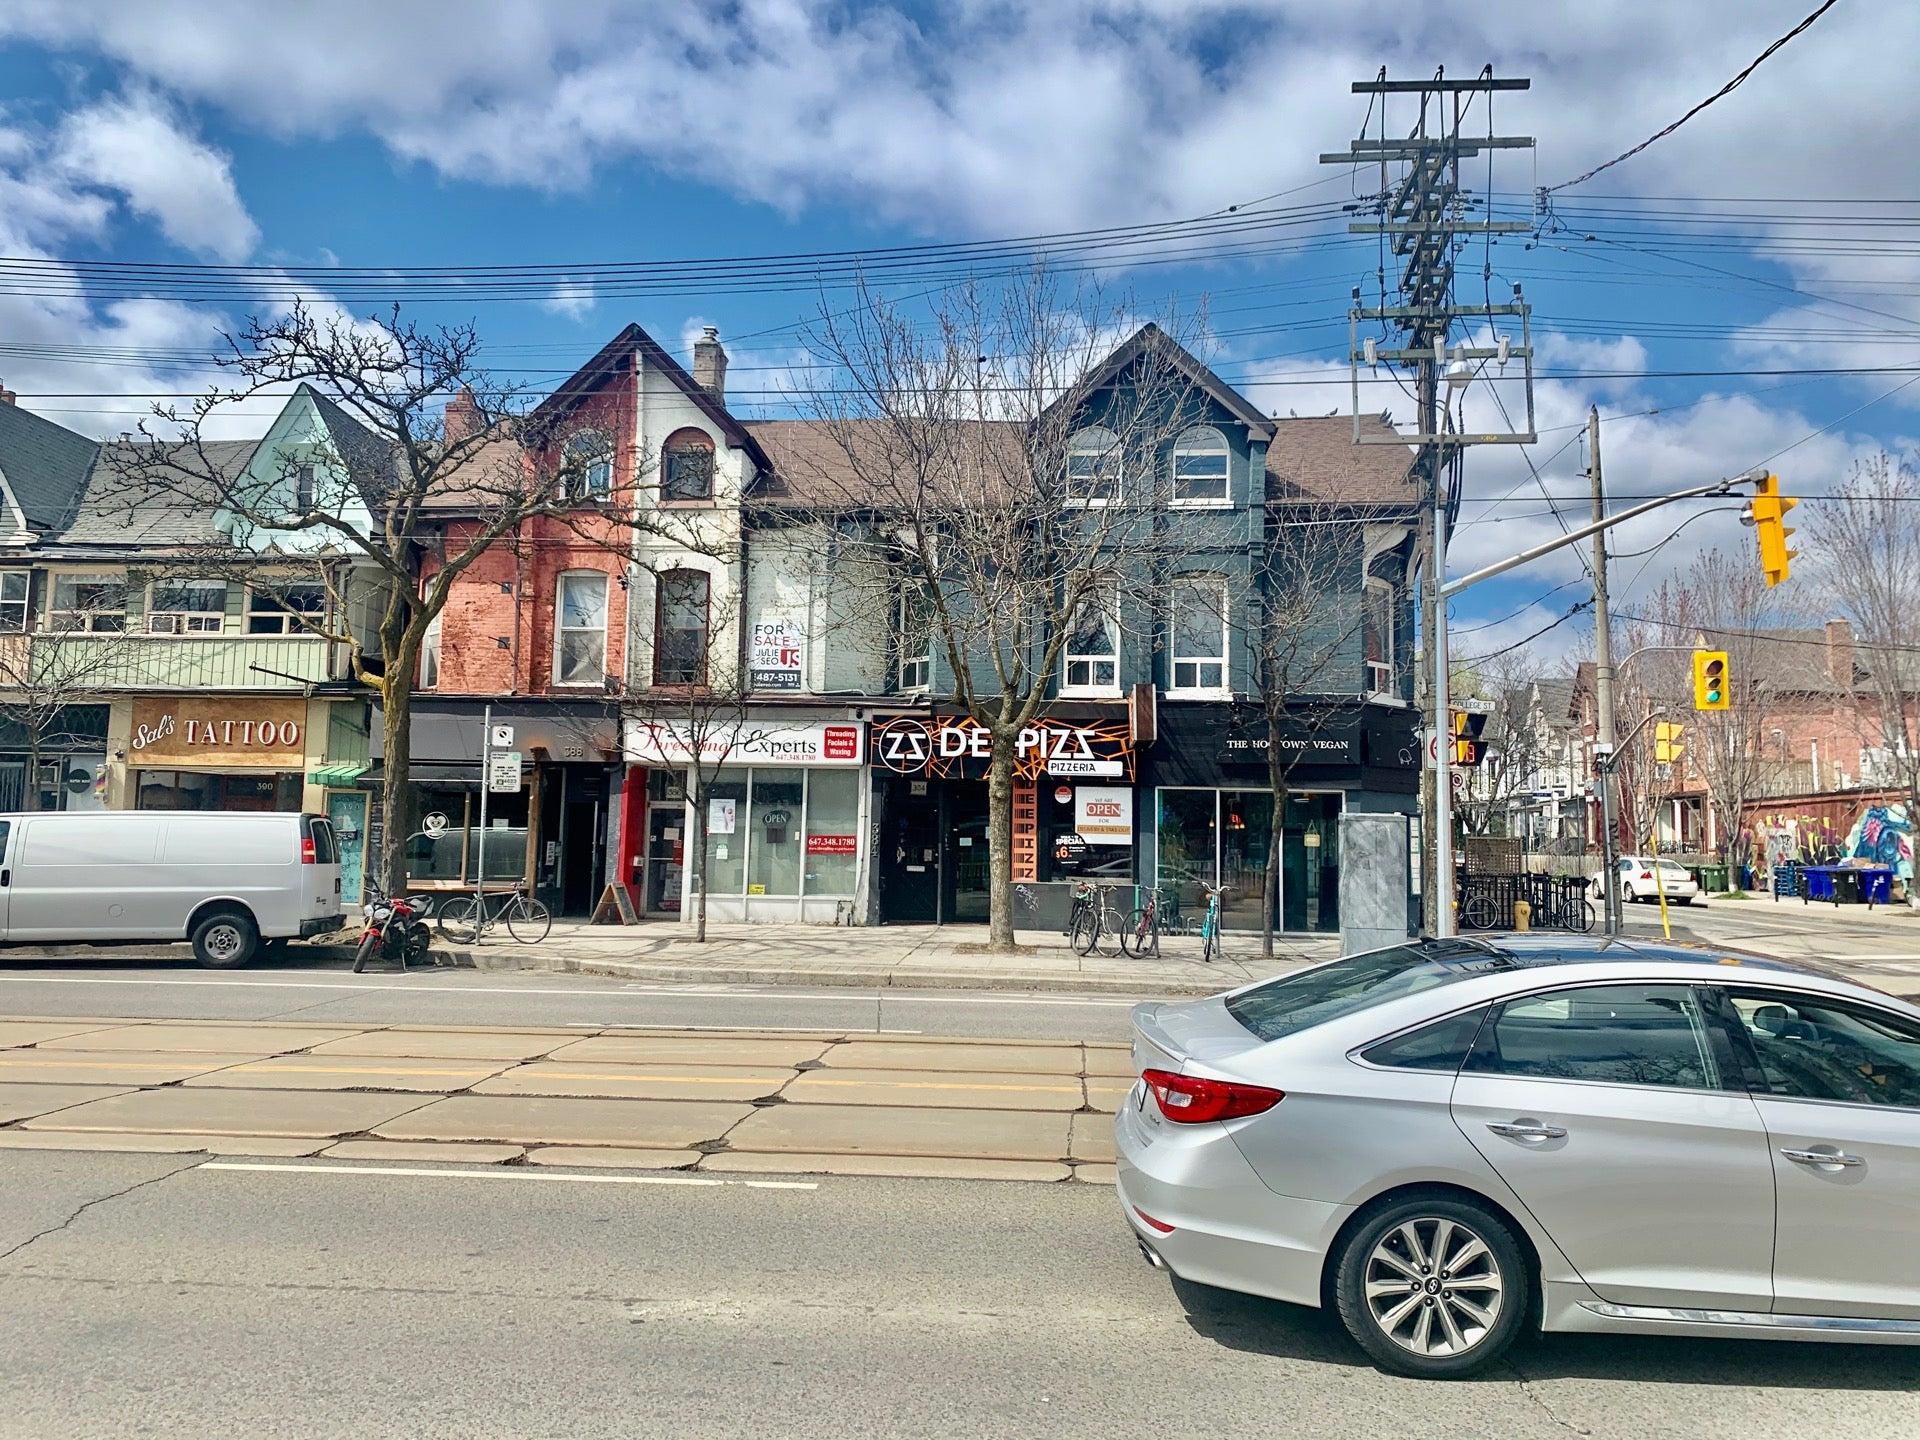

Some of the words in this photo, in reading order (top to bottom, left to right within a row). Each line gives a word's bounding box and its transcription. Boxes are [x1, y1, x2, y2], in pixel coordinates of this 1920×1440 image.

[755, 624, 784, 635] FOR
[754, 635, 791, 647] SALE
[755, 648, 779, 657] JULIE
[760, 657, 779, 666] SEO
[1483, 702, 1492, 710] ST
[132, 714, 175, 750] Sal's
[184, 720, 300, 747] TATTOO
[826, 730, 856, 738] Threading
[743, 729, 817, 757] Experts
[1226, 740, 1248, 749] THE
[1252, 740, 1308, 749] HOOWN
[1312, 740, 1349, 749] VEGAN
[830, 748, 851, 757] Waxing
[1051, 762, 1096, 772] PIZZERIA
[1087, 804, 1120, 815] OPEN
[764, 813, 787, 823] OPEN
[808, 837, 855, 846] 647.348.1780
[1055, 838, 1084, 846] SPECIAL
